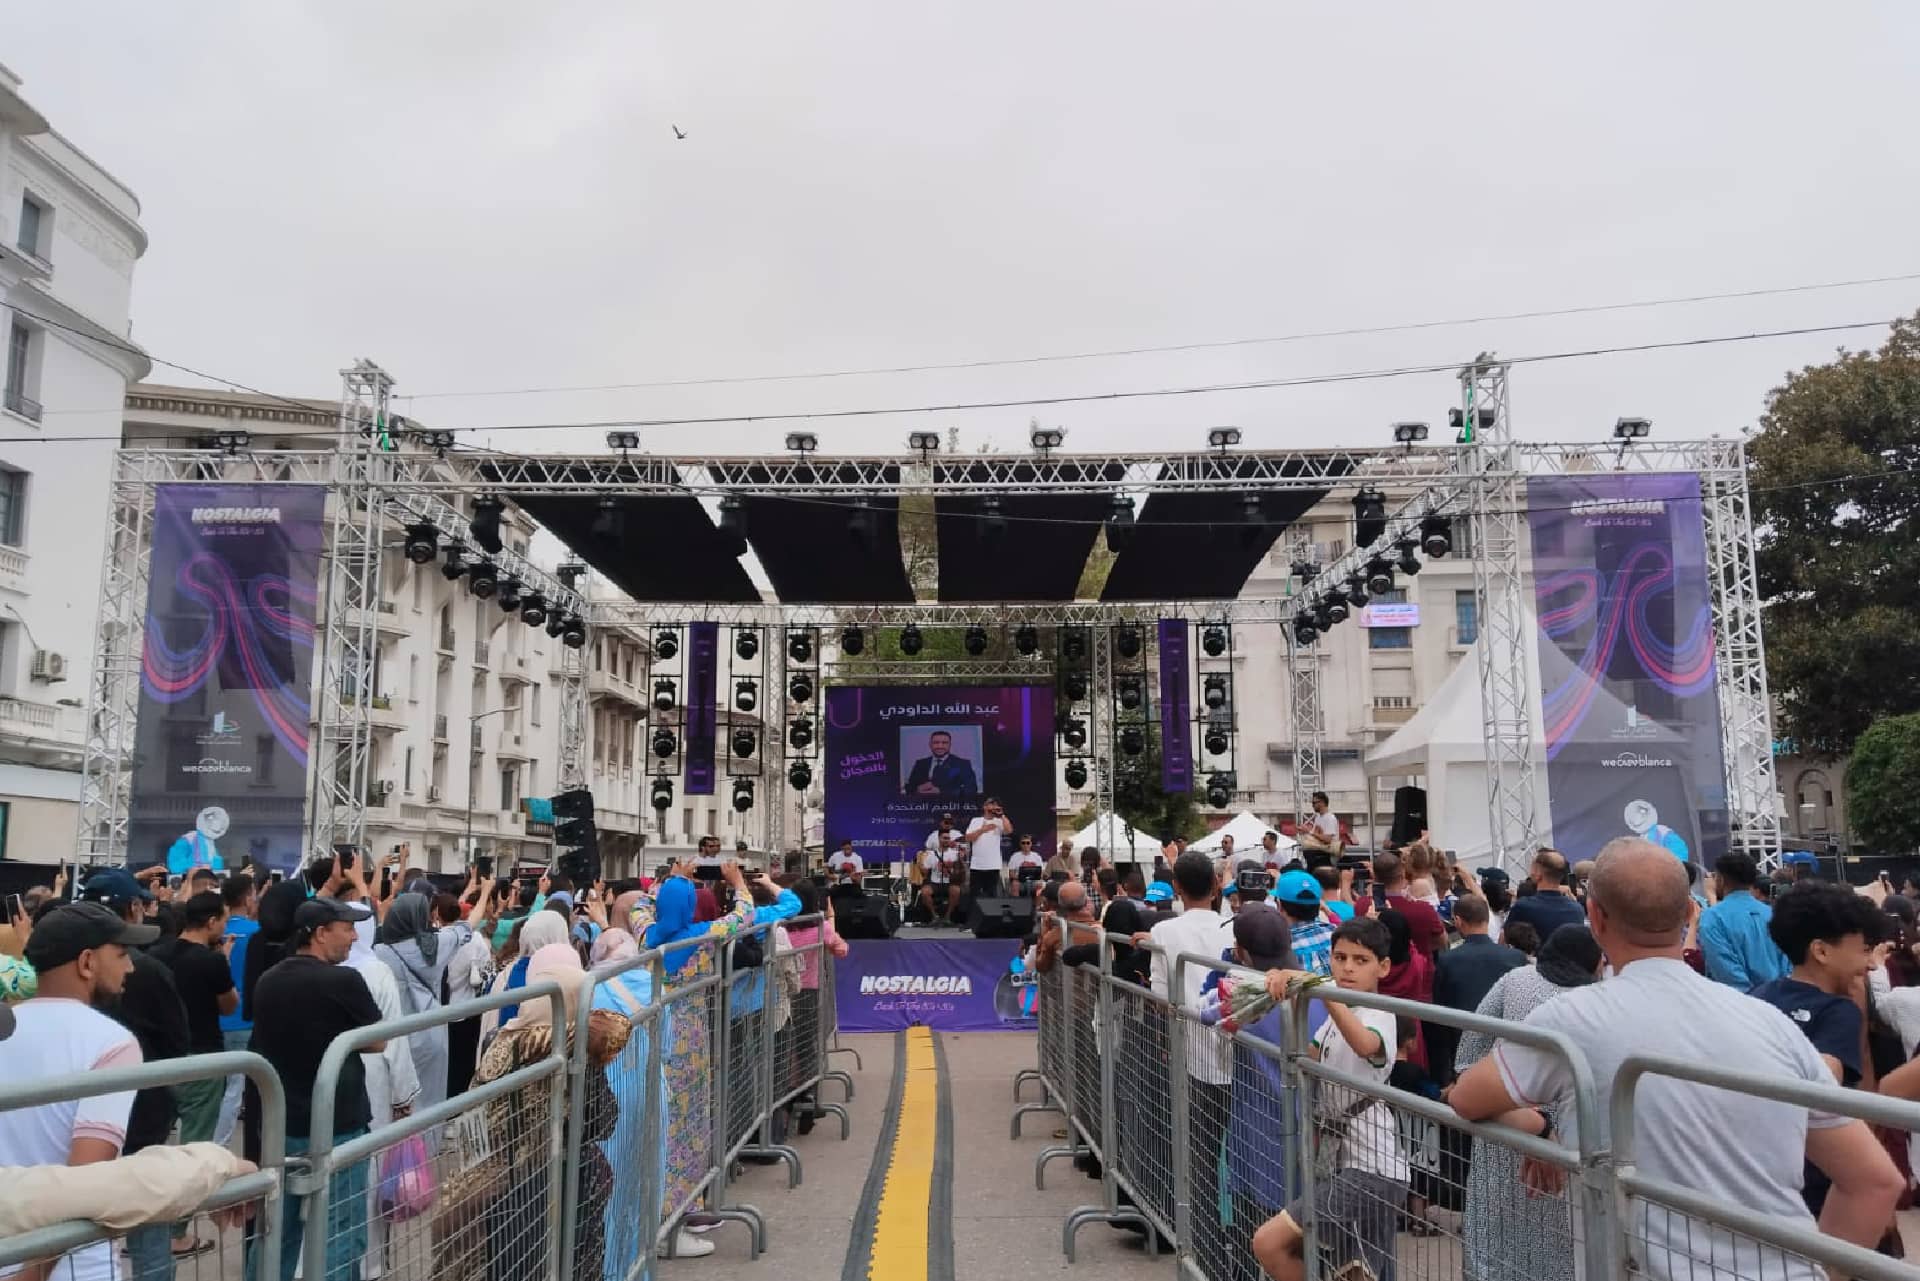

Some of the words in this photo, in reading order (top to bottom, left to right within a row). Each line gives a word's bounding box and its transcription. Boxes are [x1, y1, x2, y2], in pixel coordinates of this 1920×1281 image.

[191, 507, 281, 524] NOSTALGIA
[879, 703, 940, 720] الداودي
[944, 701, 970, 713] الله
[975, 703, 1000, 717] عبد
[860, 976, 972, 995] NOSTALGIA
